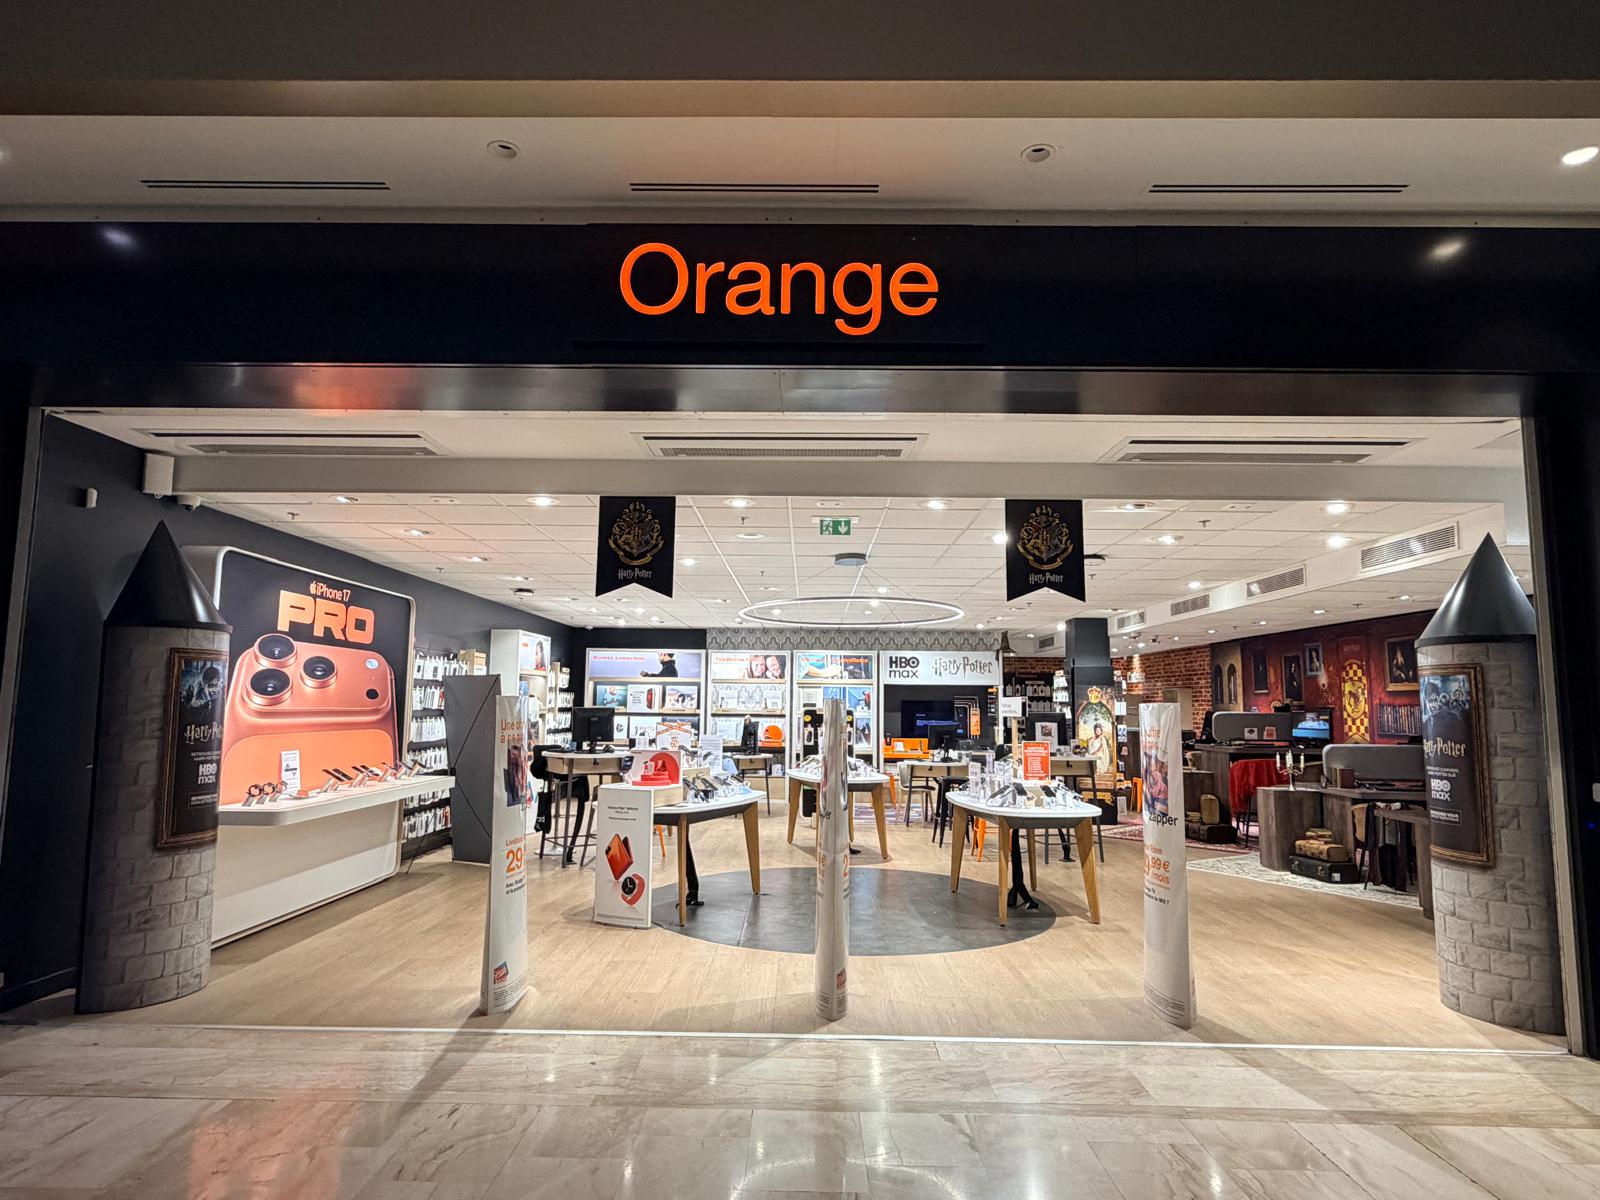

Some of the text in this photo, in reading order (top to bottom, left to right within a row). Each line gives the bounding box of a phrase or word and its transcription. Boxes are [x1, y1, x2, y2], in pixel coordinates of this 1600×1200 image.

[620, 242, 938, 336] Orange
[618, 567, 653, 580] Harry Potter
[1028, 571, 1063, 585] Harry Potter
[316, 582, 351, 602] iPhone 17
[277, 589, 375, 645] PRO
[889, 655, 920, 669] HBO
[932, 656, 993, 679] Harry Potter
[889, 669, 919, 679] max
[184, 724, 212, 744] Harry
[1436, 737, 1466, 756] Potter
[199, 762, 218, 776] HBO
[198, 774, 217, 785] max
[1431, 778, 1451, 792] HBO
[1431, 790, 1451, 802] max
[1149, 812, 1178, 827] zapper
